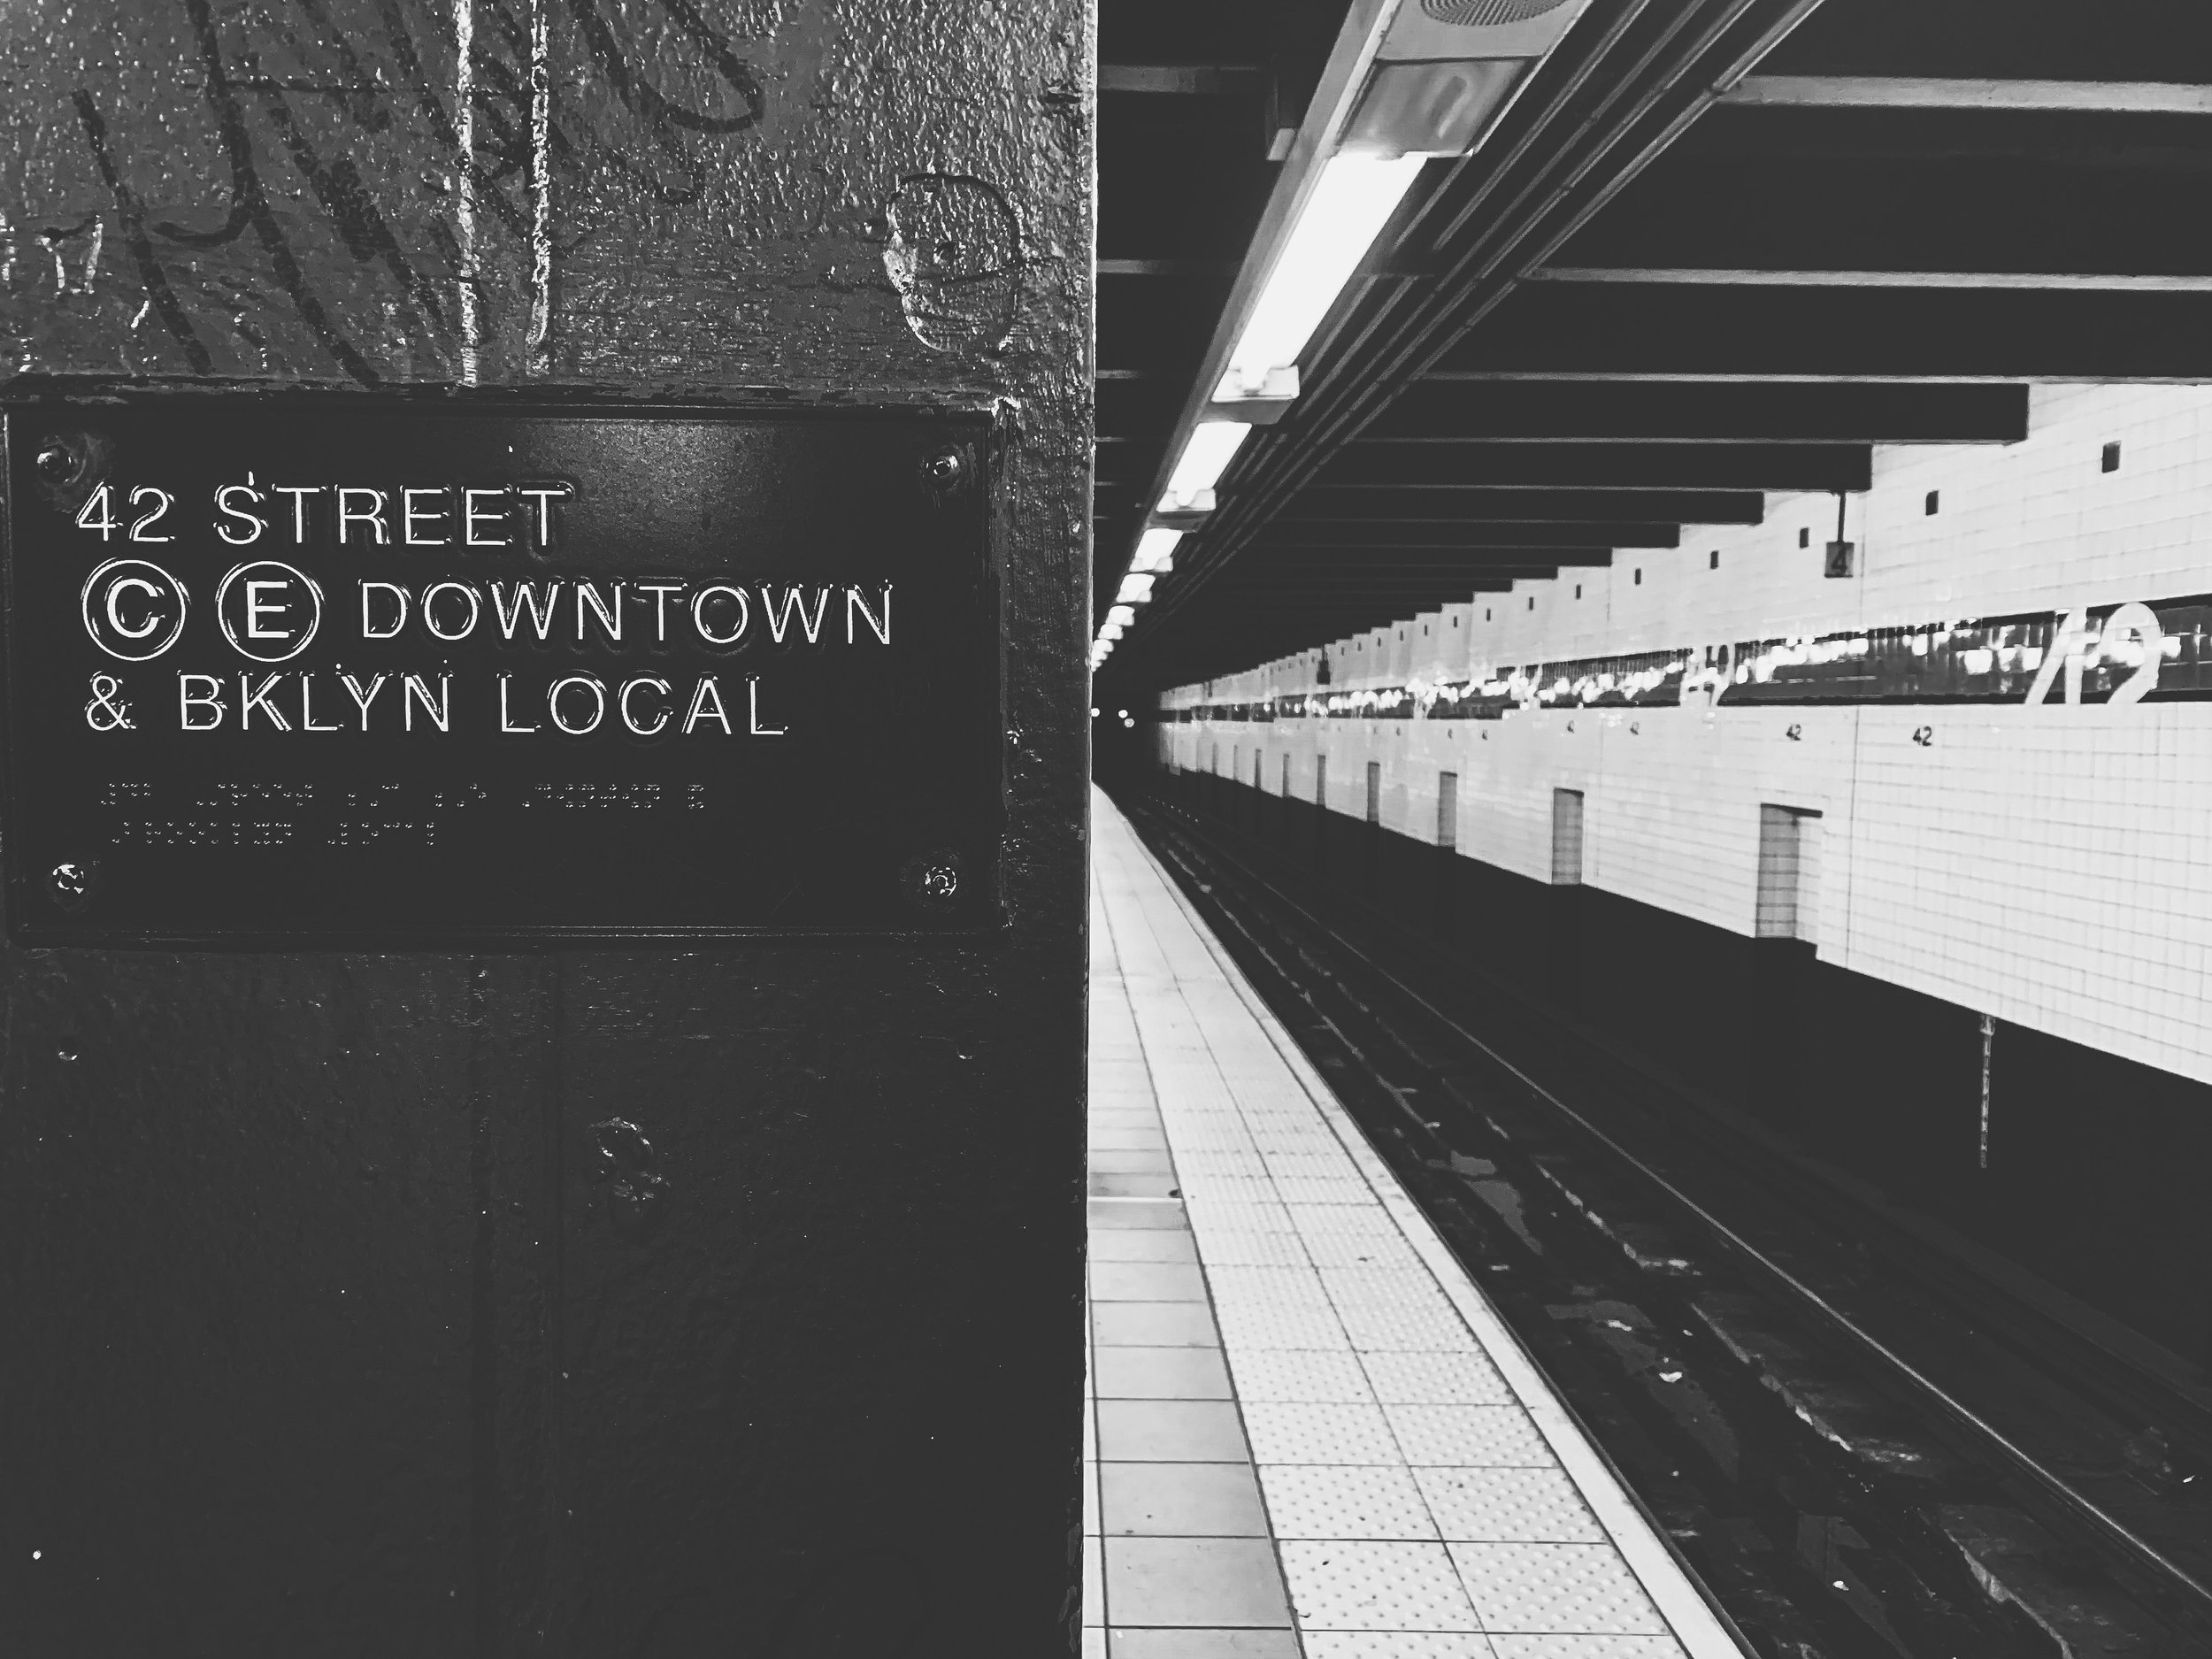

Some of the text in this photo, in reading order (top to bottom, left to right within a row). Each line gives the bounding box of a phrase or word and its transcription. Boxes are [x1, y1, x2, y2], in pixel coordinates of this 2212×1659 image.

[76, 482, 572, 546] 42 STREET
[359, 576, 893, 645] DOWNTOWN
[85, 670, 788, 735] & BKLYN LOCAL
[1786, 723, 1801, 741] 42
[1912, 726, 1932, 747] 42
